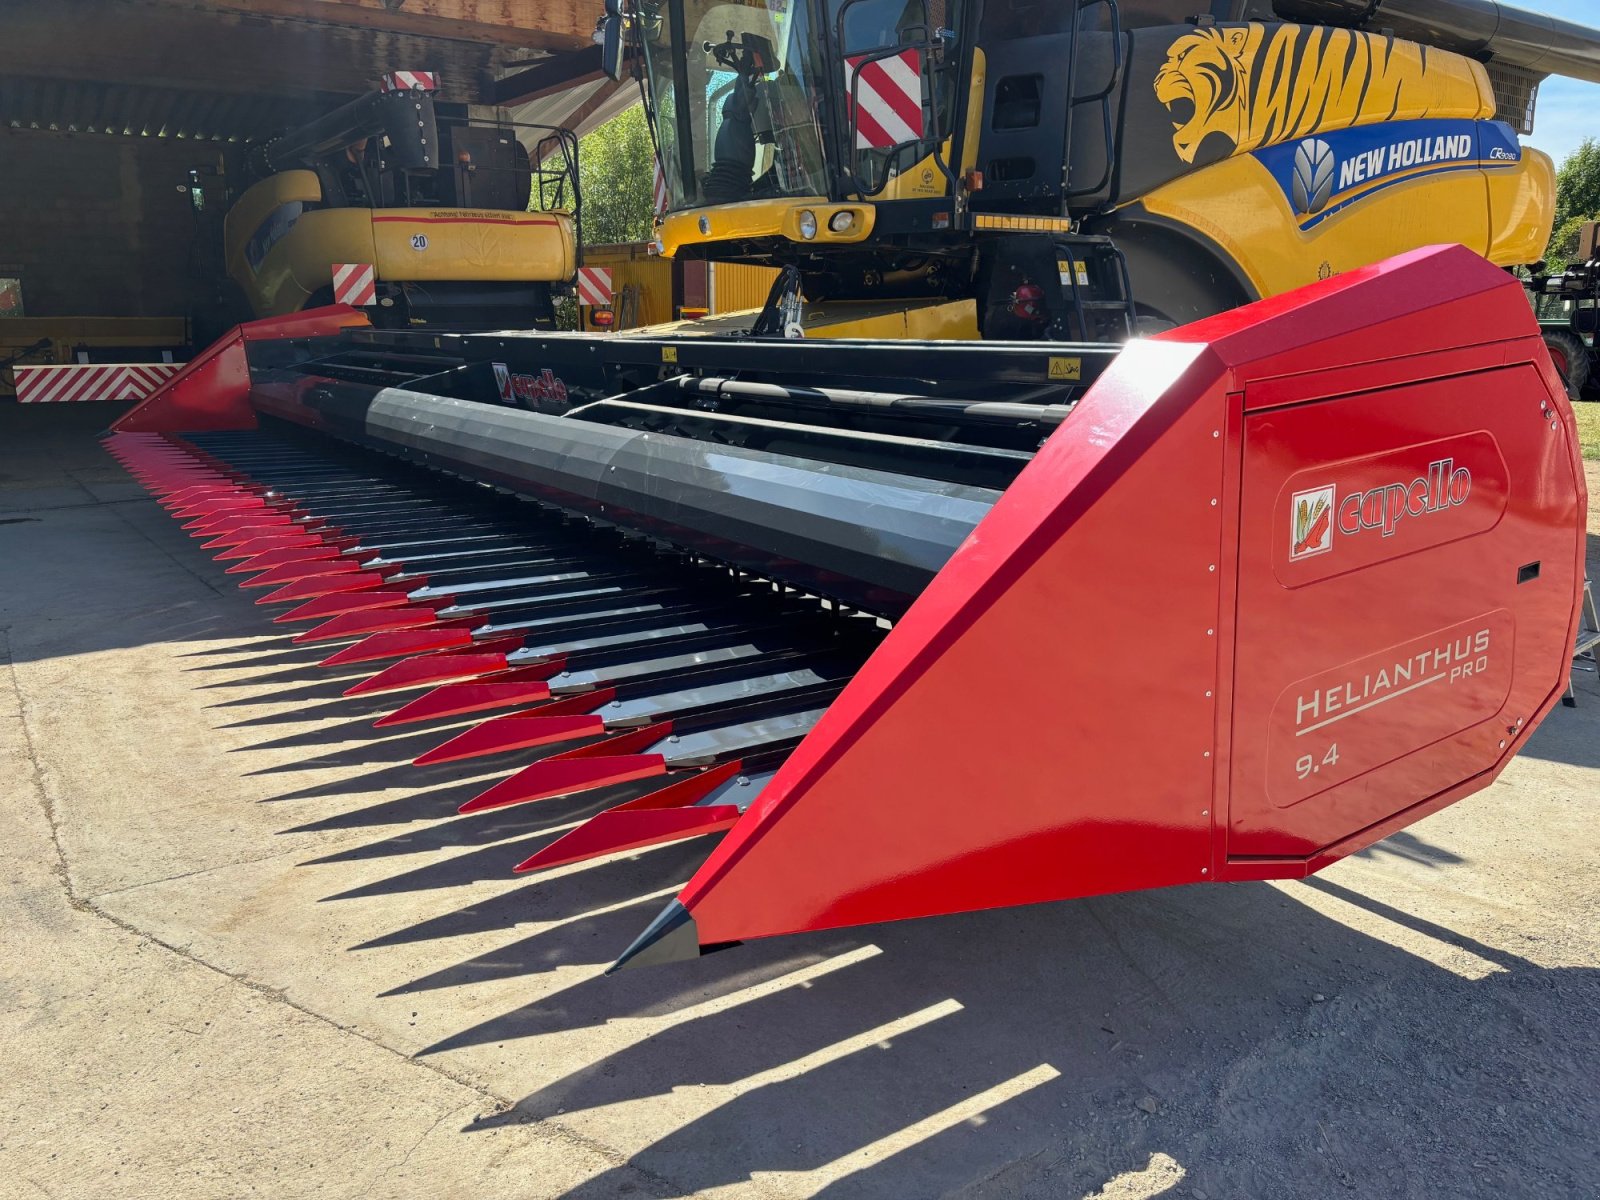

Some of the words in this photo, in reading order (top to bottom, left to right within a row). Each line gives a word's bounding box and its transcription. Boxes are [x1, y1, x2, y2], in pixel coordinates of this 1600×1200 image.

[1338, 145, 1386, 190] NEW
[1388, 135, 1472, 171] HOLLAND
[412, 235, 426, 248] 20
[1338, 457, 1472, 538] capello
[1296, 629, 1490, 725] HELIANTHUS
[1450, 655, 1488, 684] PRO
[1296, 743, 1340, 780] 9.4
